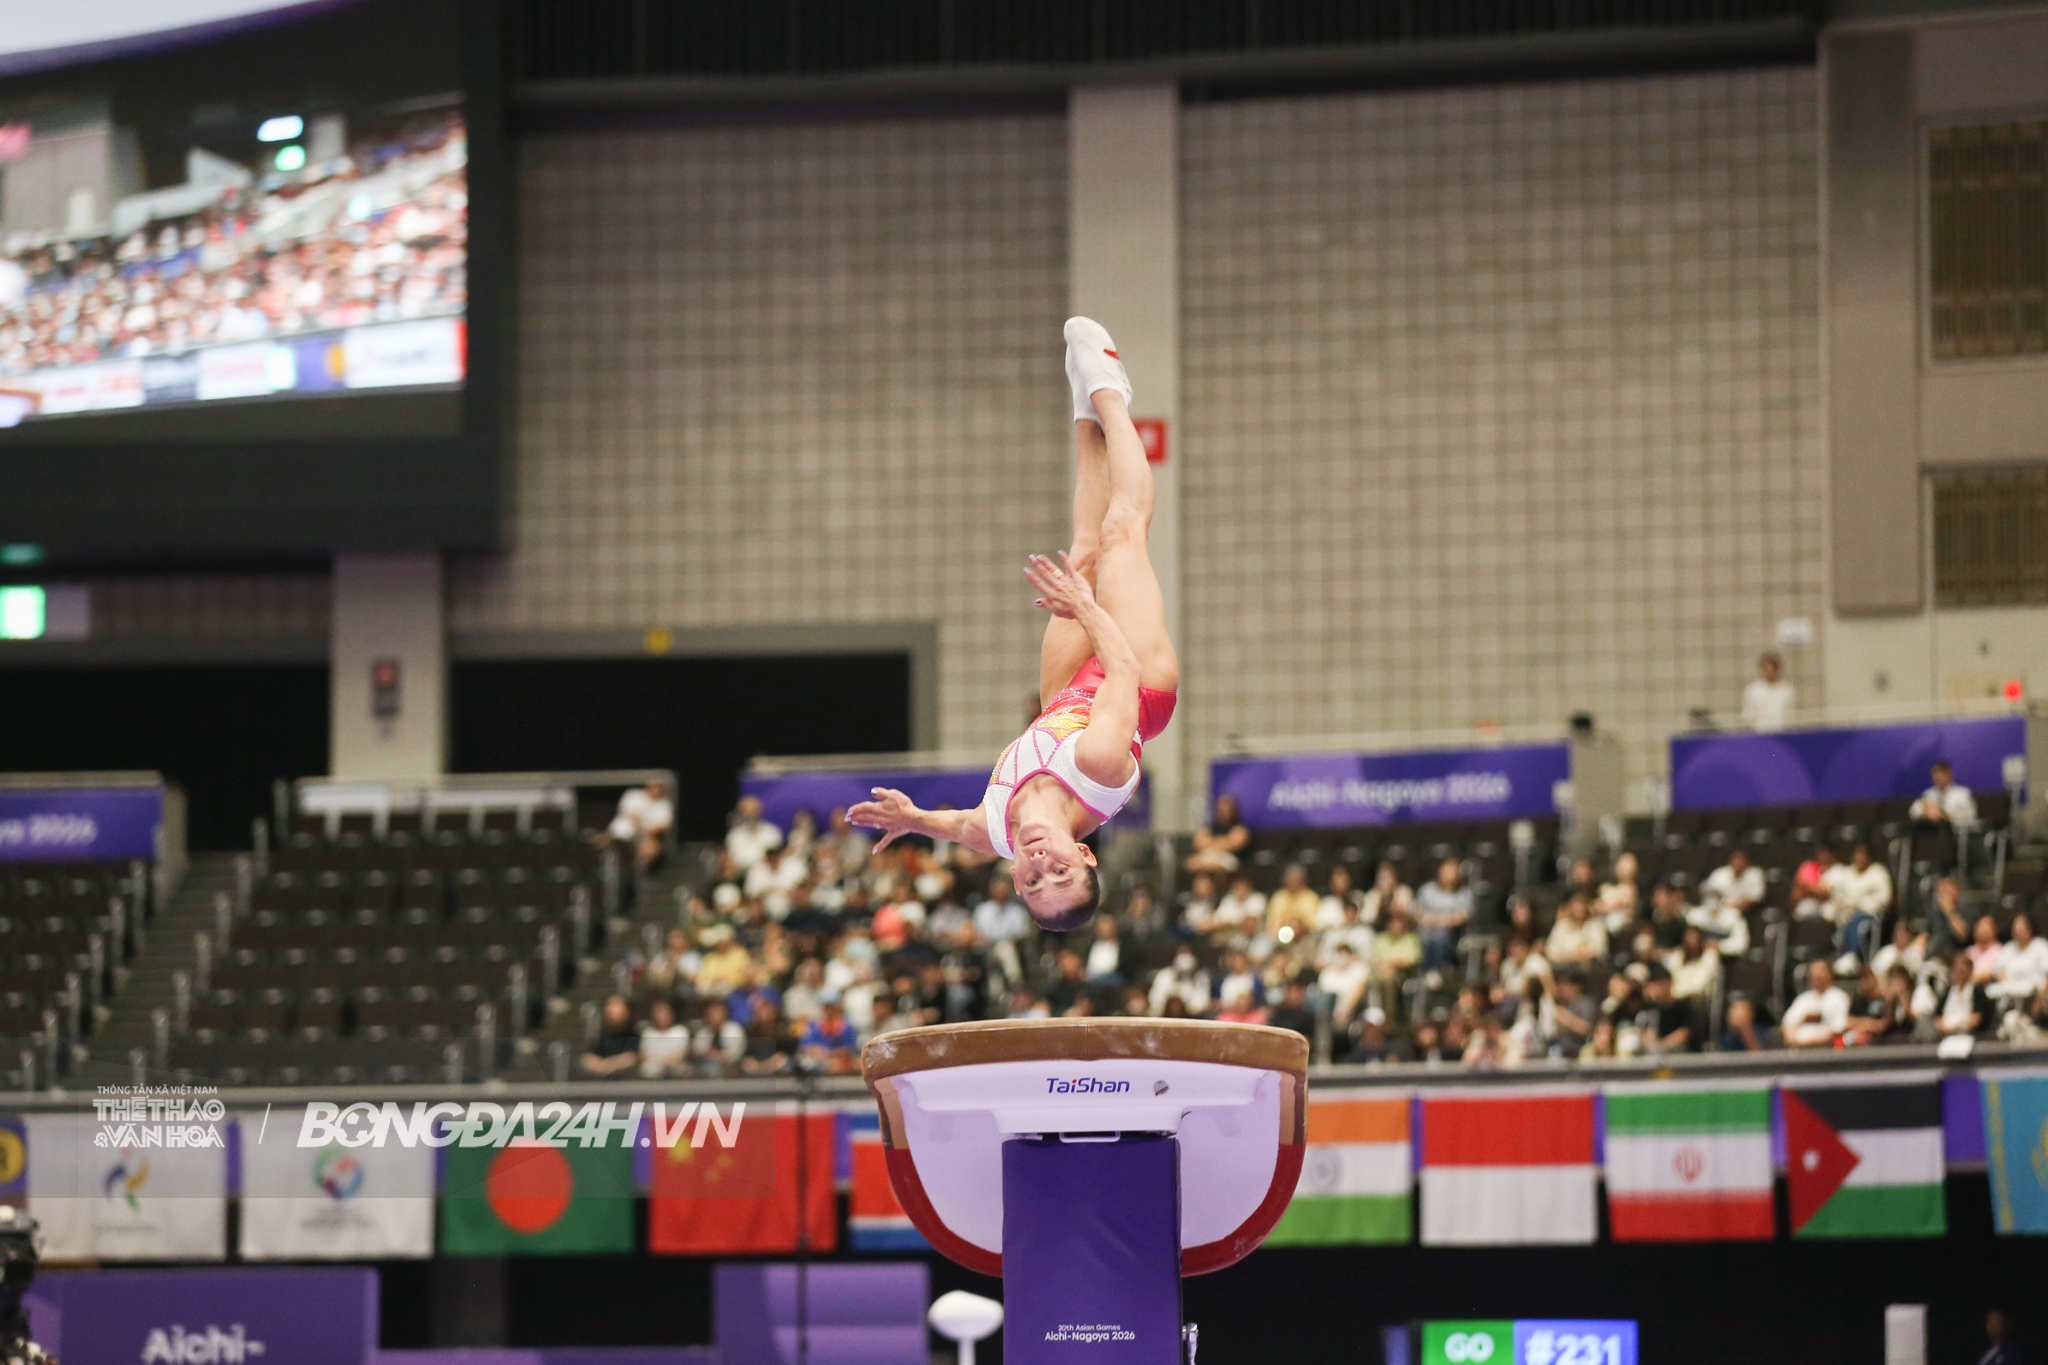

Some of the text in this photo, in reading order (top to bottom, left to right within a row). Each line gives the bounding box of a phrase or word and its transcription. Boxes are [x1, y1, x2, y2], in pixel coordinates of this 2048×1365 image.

[1046, 1077, 1130, 1093] TaiShan
[1058, 1323, 1121, 1332] 20th Asian Games
[1044, 1331, 1136, 1343] Aichi-Nagoya 2026
[1444, 1332, 1495, 1363] GO
[1525, 1329, 1621, 1365] #231
